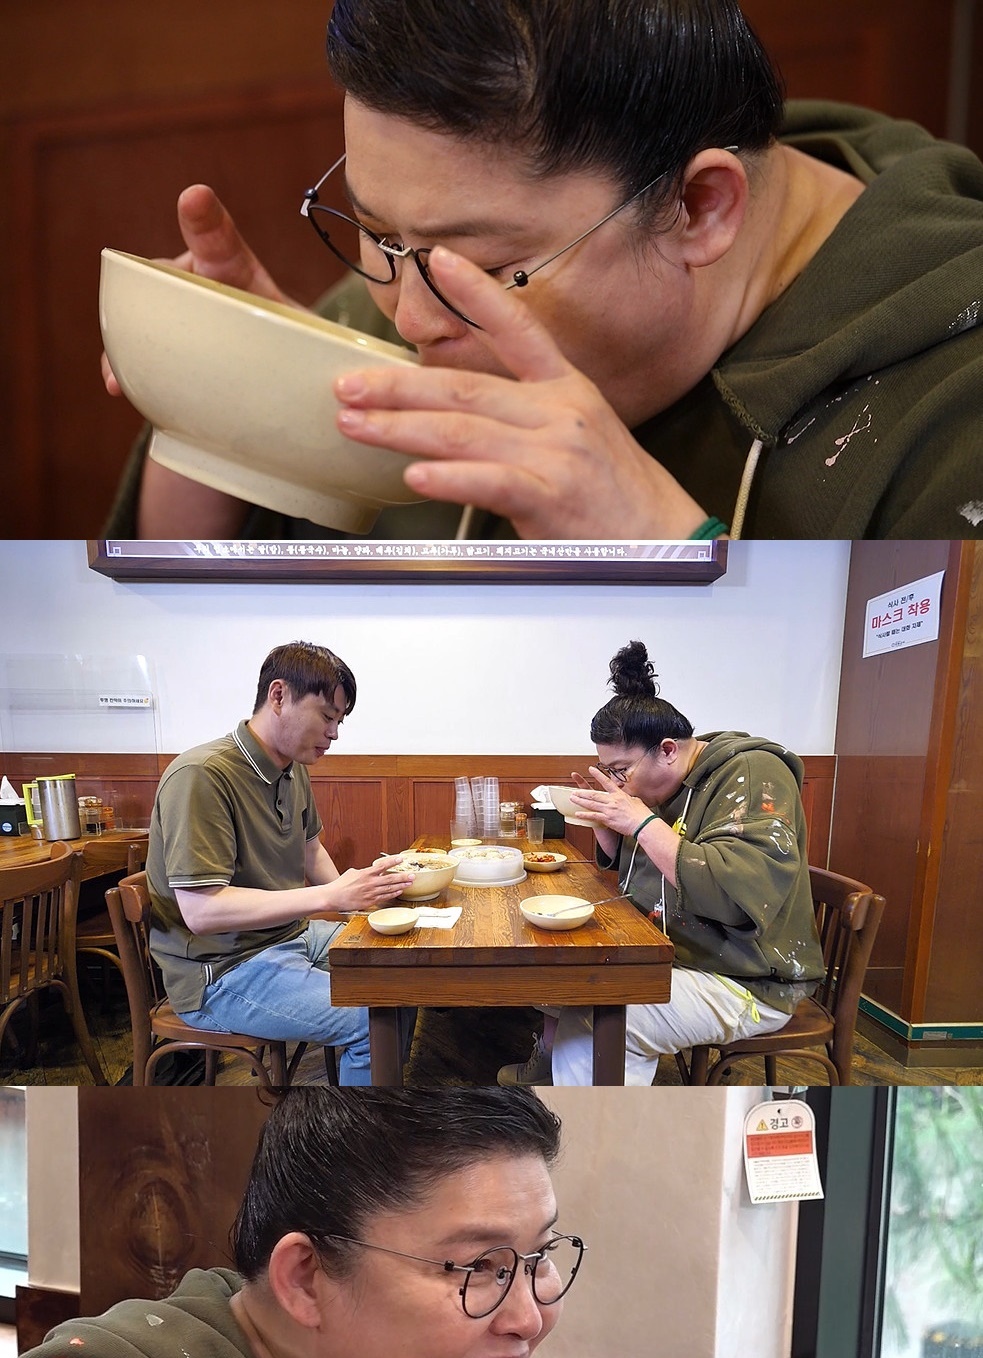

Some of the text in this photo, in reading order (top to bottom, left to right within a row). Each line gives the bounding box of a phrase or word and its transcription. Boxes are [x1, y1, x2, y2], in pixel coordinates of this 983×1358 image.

[583, 546, 628, 557] 사용합니다.
[888, 599, 899, 609] 식사
[871, 598, 931, 629] 마스크 착용
[769, 1117, 789, 1130] 경고
